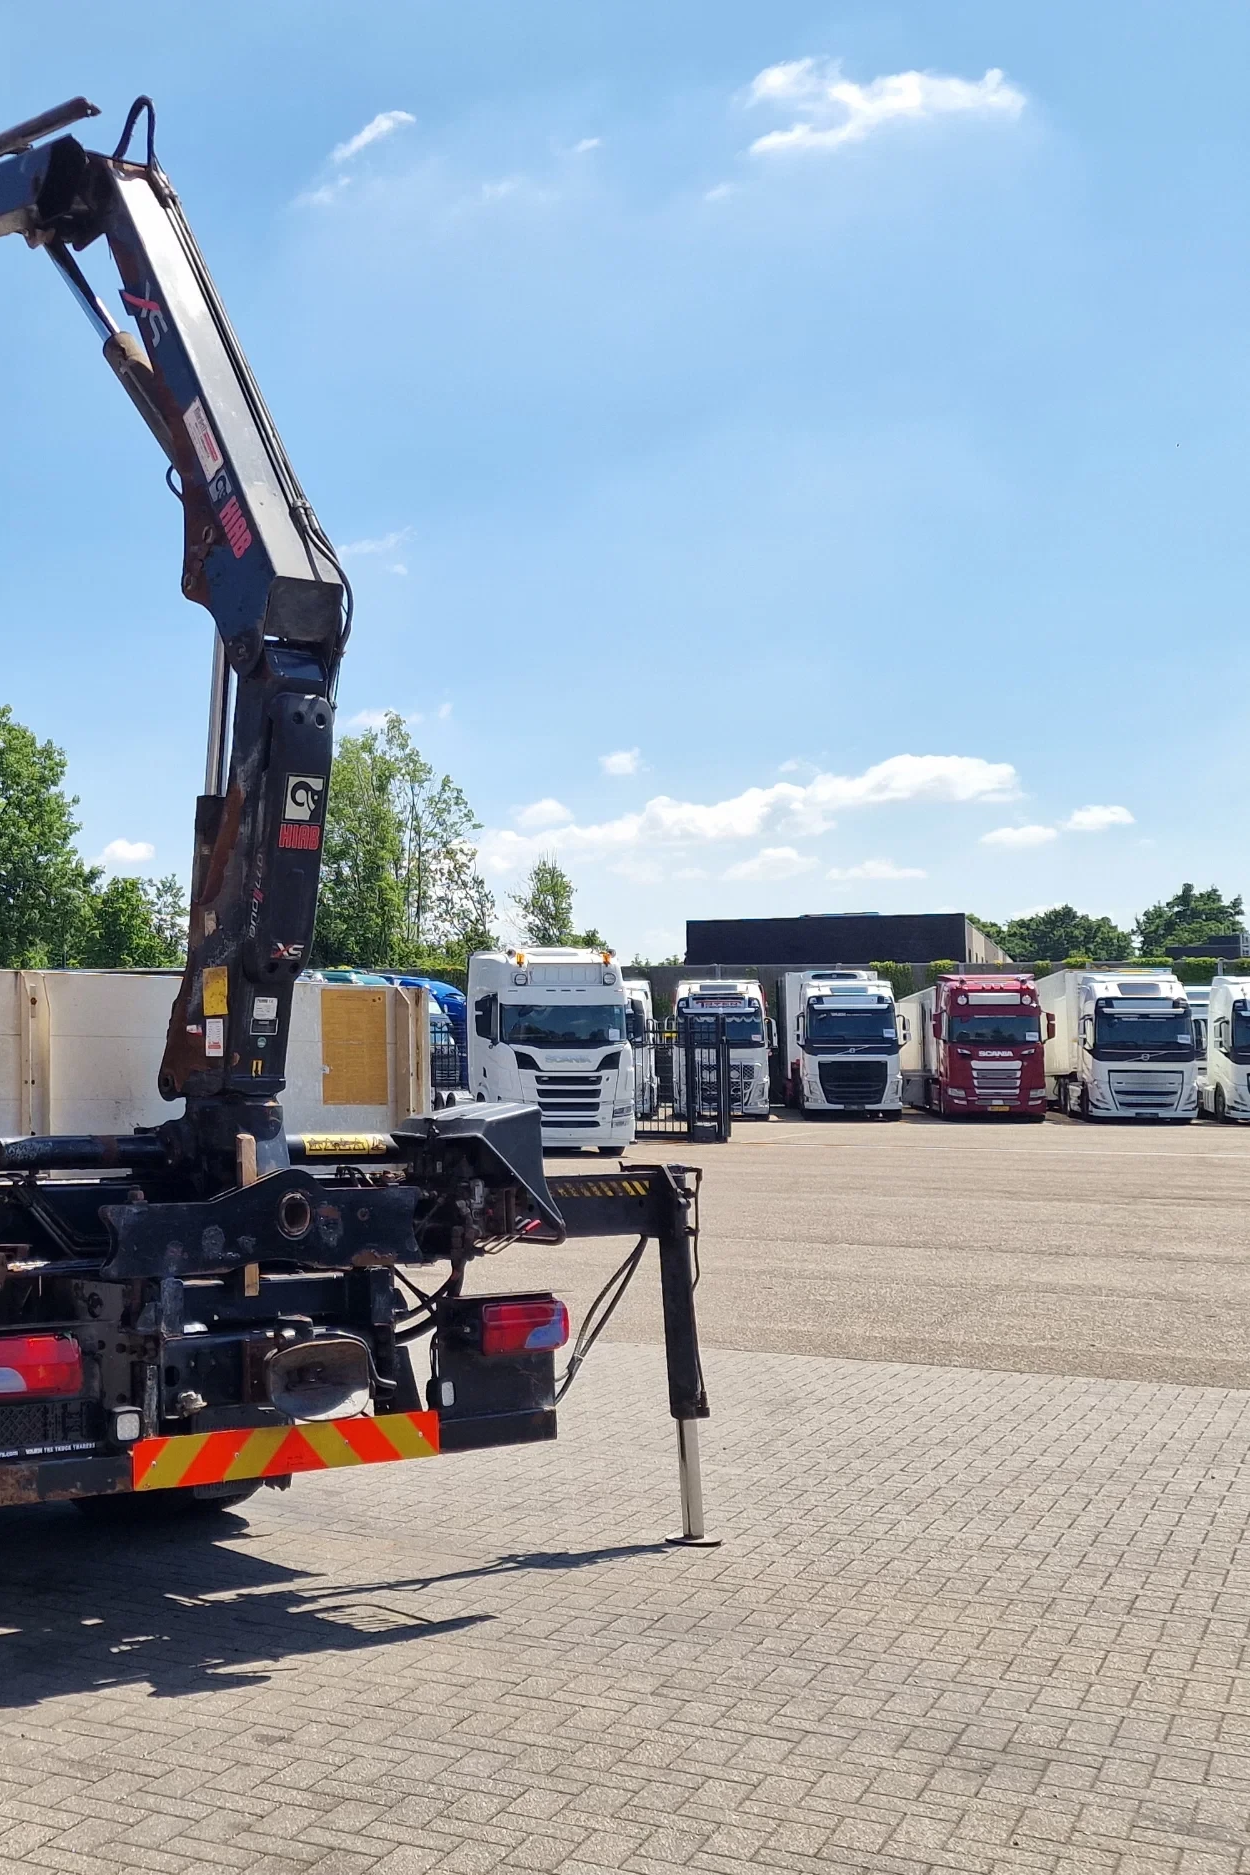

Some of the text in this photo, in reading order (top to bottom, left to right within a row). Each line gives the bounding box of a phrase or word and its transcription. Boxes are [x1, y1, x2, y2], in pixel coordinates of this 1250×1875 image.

[122, 279, 169, 348] XS
[219, 495, 253, 559] HIAB
[278, 823, 321, 851] HIAB
[271, 942, 305, 960] XS
